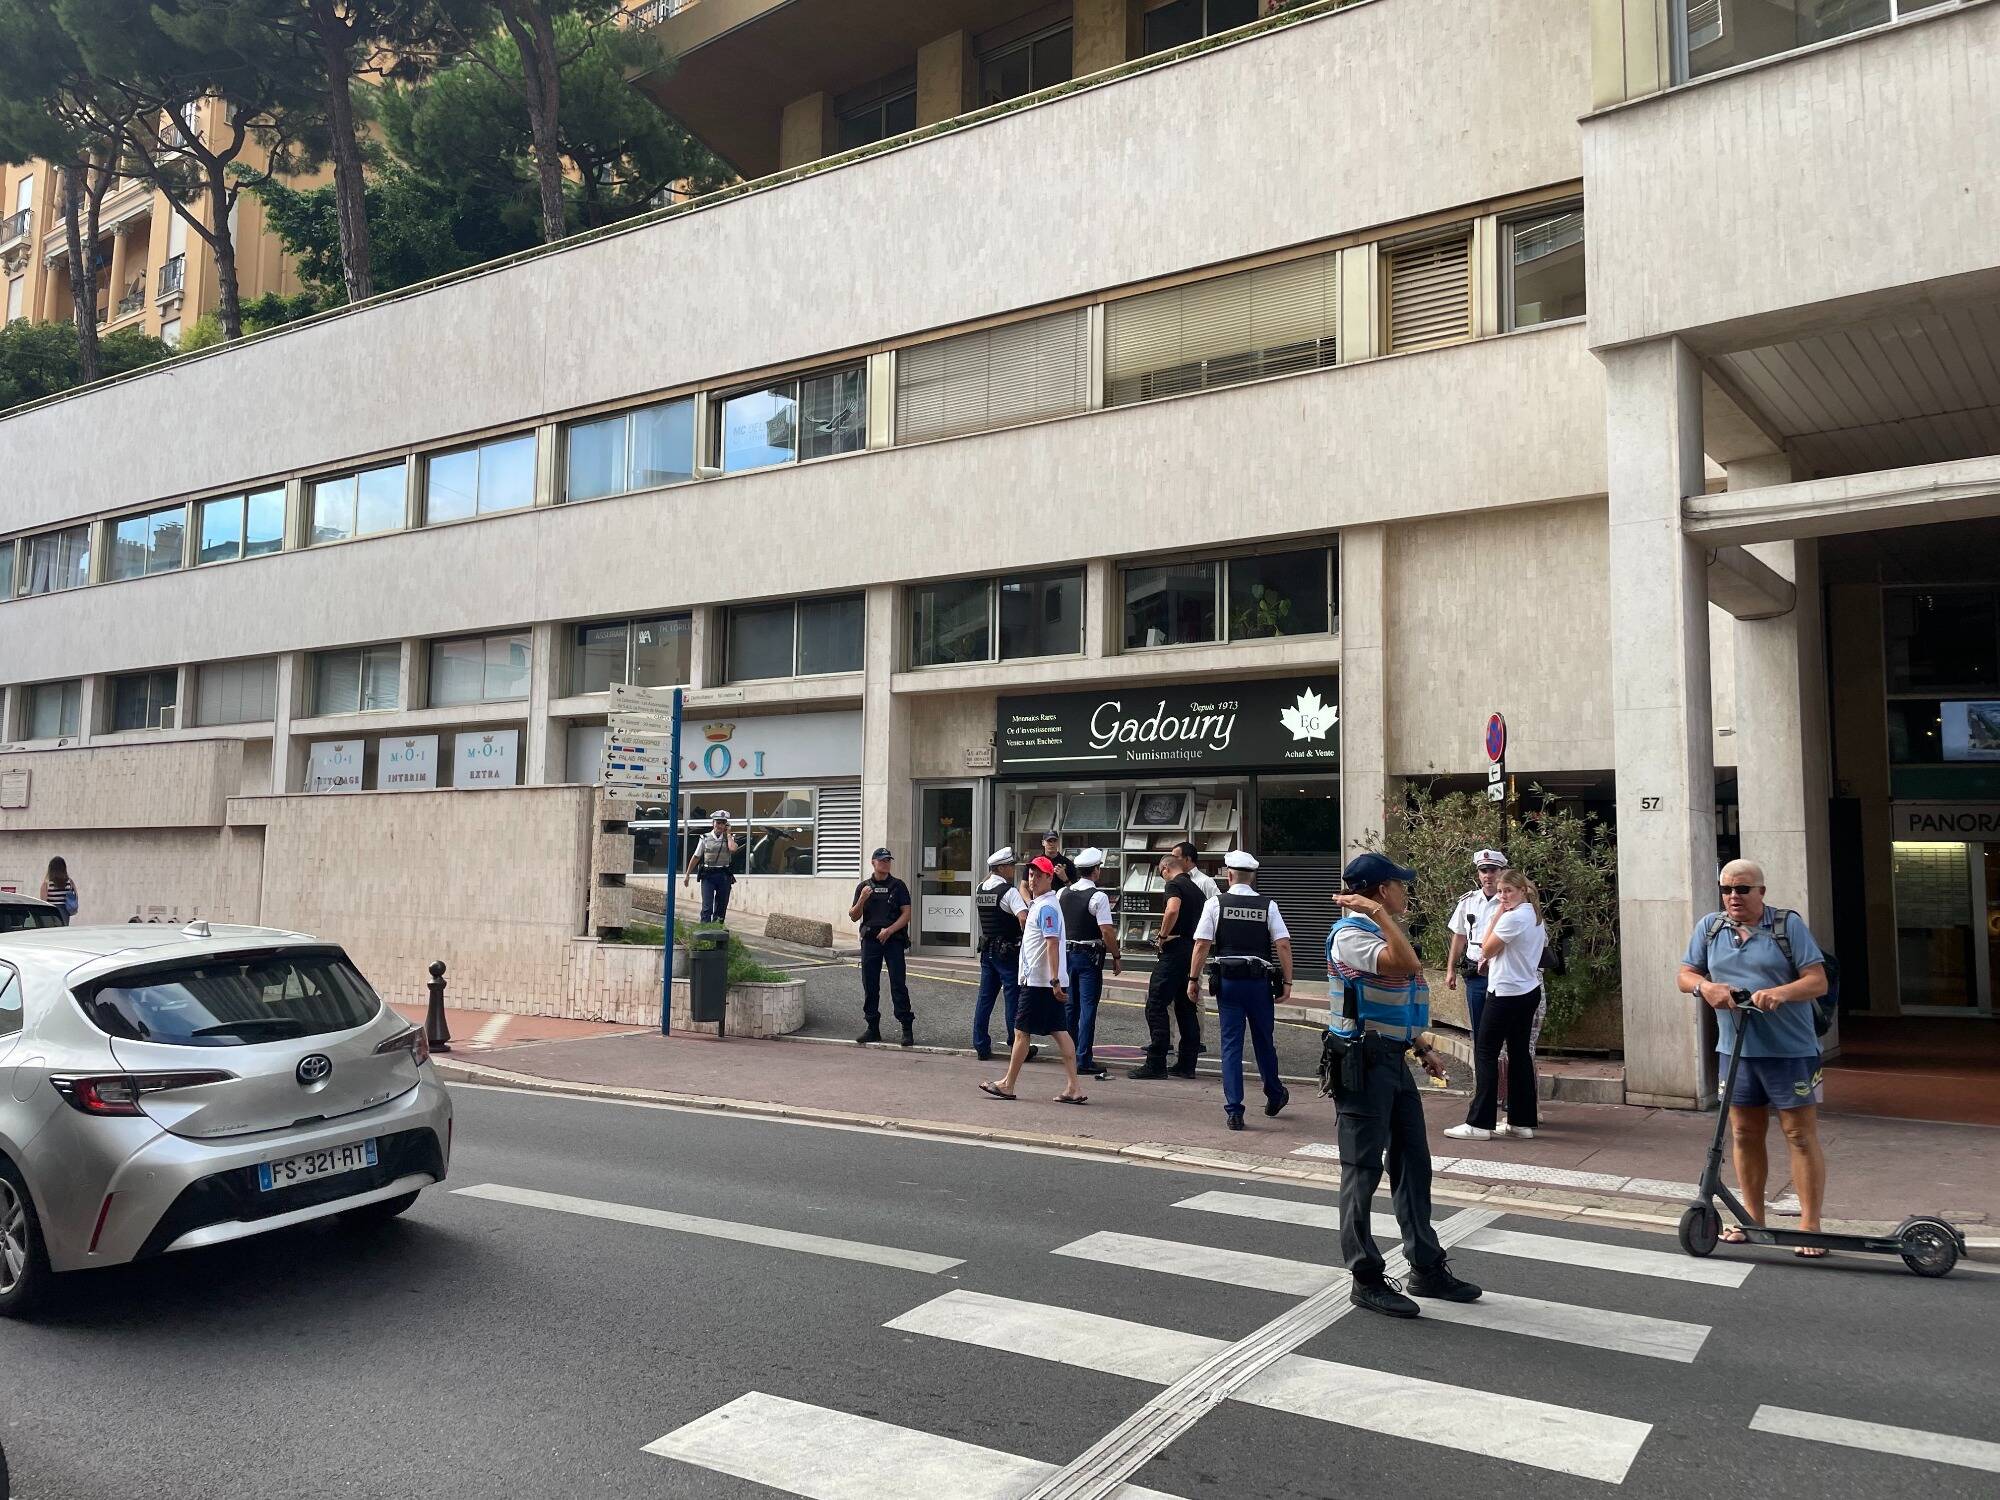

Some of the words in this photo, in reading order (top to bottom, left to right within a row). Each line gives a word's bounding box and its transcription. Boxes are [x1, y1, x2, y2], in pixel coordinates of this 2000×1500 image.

[1190, 702, 1215, 713] Depuis
[1218, 701, 1238, 710] 1973
[1088, 700, 1236, 751] Gadoury
[1126, 748, 1202, 761] Numismatique
[1284, 750, 1305, 758] Achat
[1306, 749, 1313, 757] &
[1314, 749, 1335, 757] Vente
[388, 773, 426, 783] INTERIM
[470, 769, 500, 779] EXTRA
[1642, 797, 1660, 809] 57
[928, 906, 964, 915] EXTRA
[1227, 909, 1263, 919] POLICE
[1045, 916, 1053, 928] 1
